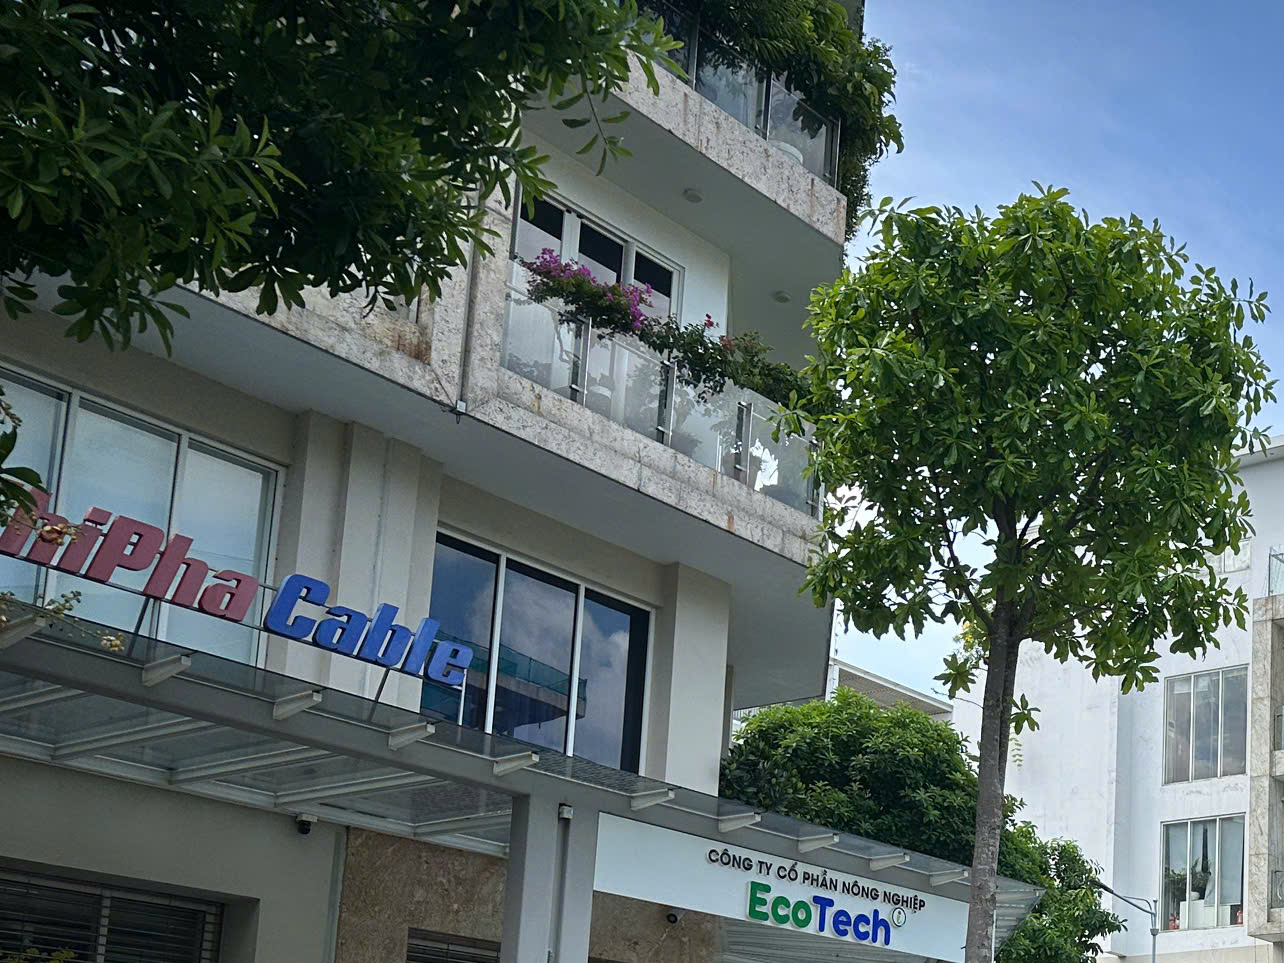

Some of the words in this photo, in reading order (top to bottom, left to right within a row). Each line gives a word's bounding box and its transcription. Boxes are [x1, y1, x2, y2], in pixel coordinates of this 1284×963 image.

[0, 483, 260, 622] hiPha
[264, 573, 474, 686] Cable
[707, 848, 753, 871] CÔNG
[757, 860, 772, 876] TY
[776, 862, 798, 882] CỔ
[802, 869, 838, 892] PHẦN
[842, 881, 880, 900] NÔNG
[883, 891, 926, 914] NGHIỆP
[748, 881, 892, 946] EcoTech
